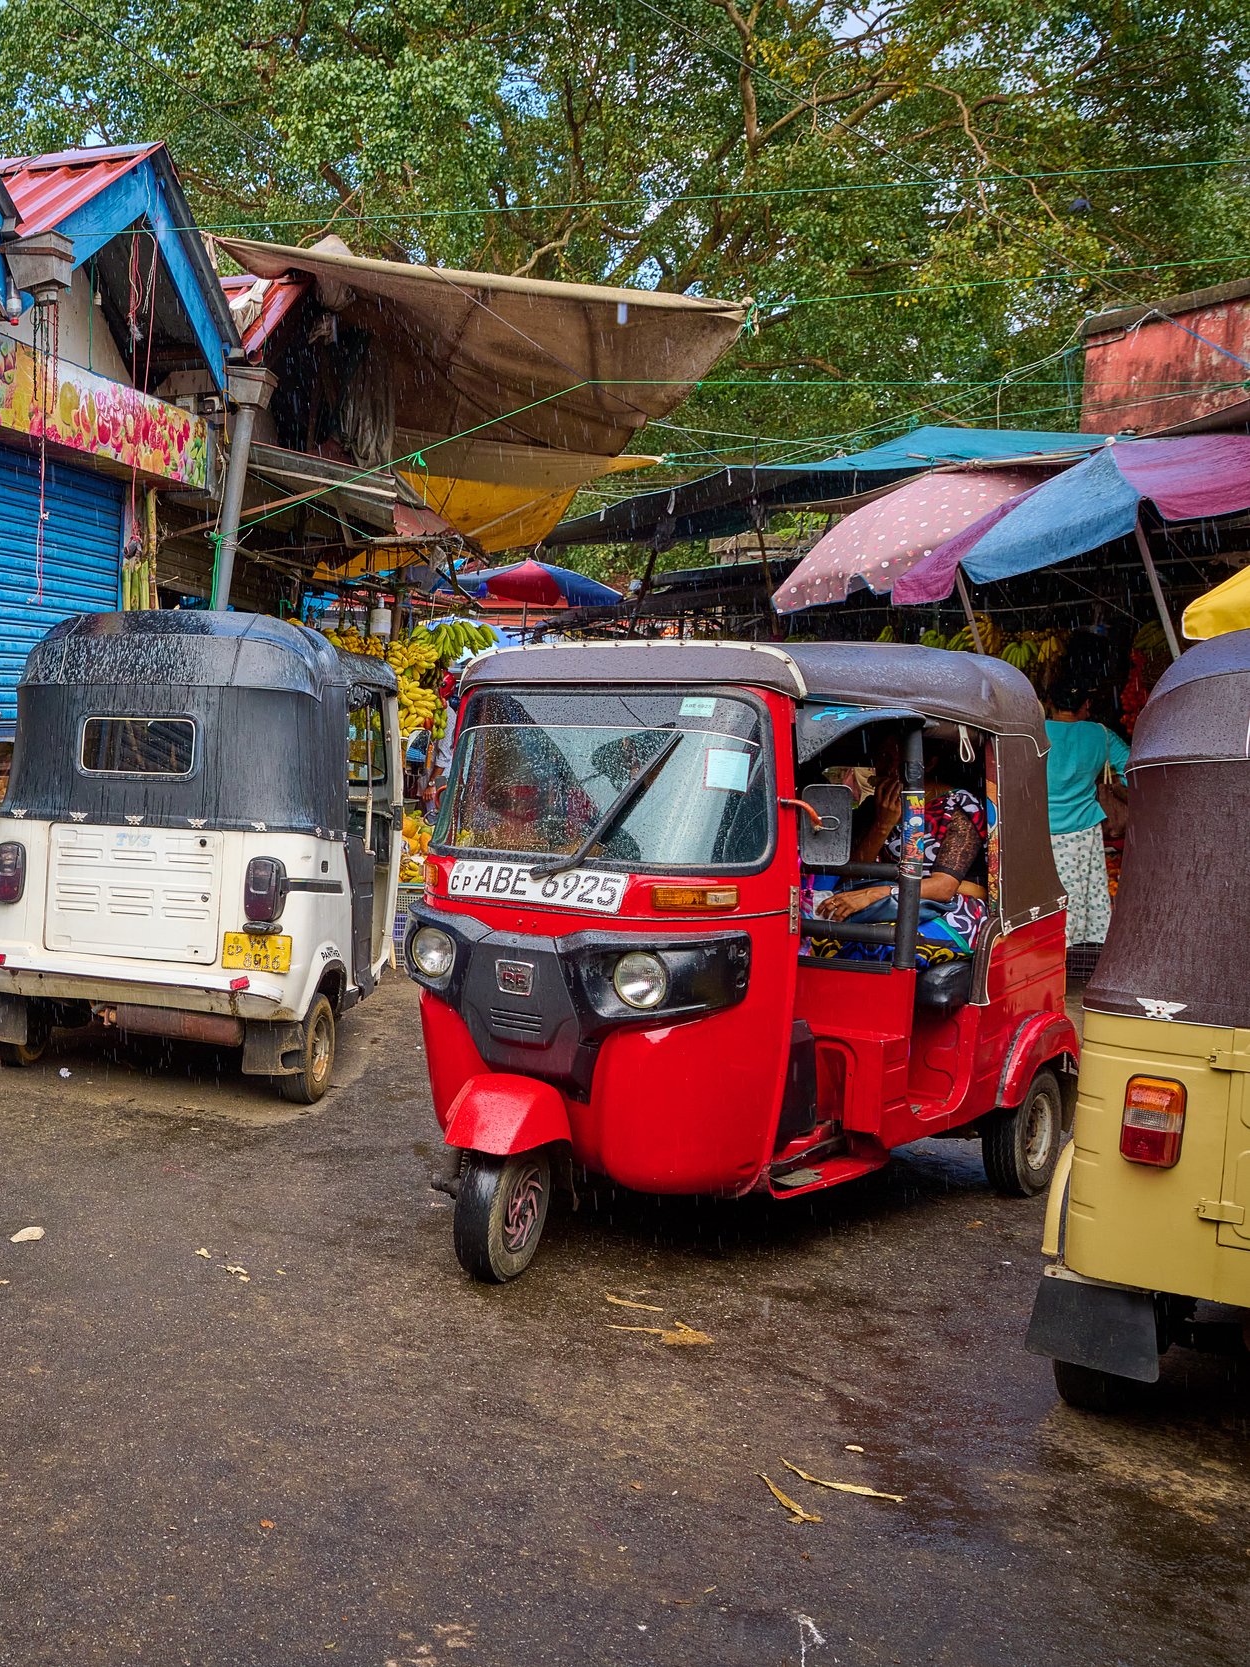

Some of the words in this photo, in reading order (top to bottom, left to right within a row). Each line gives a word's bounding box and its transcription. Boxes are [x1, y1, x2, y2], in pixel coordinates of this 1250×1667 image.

[475, 866, 531, 895] ABE
[541, 872, 622, 906] 6925
[227, 944, 243, 956] CP
